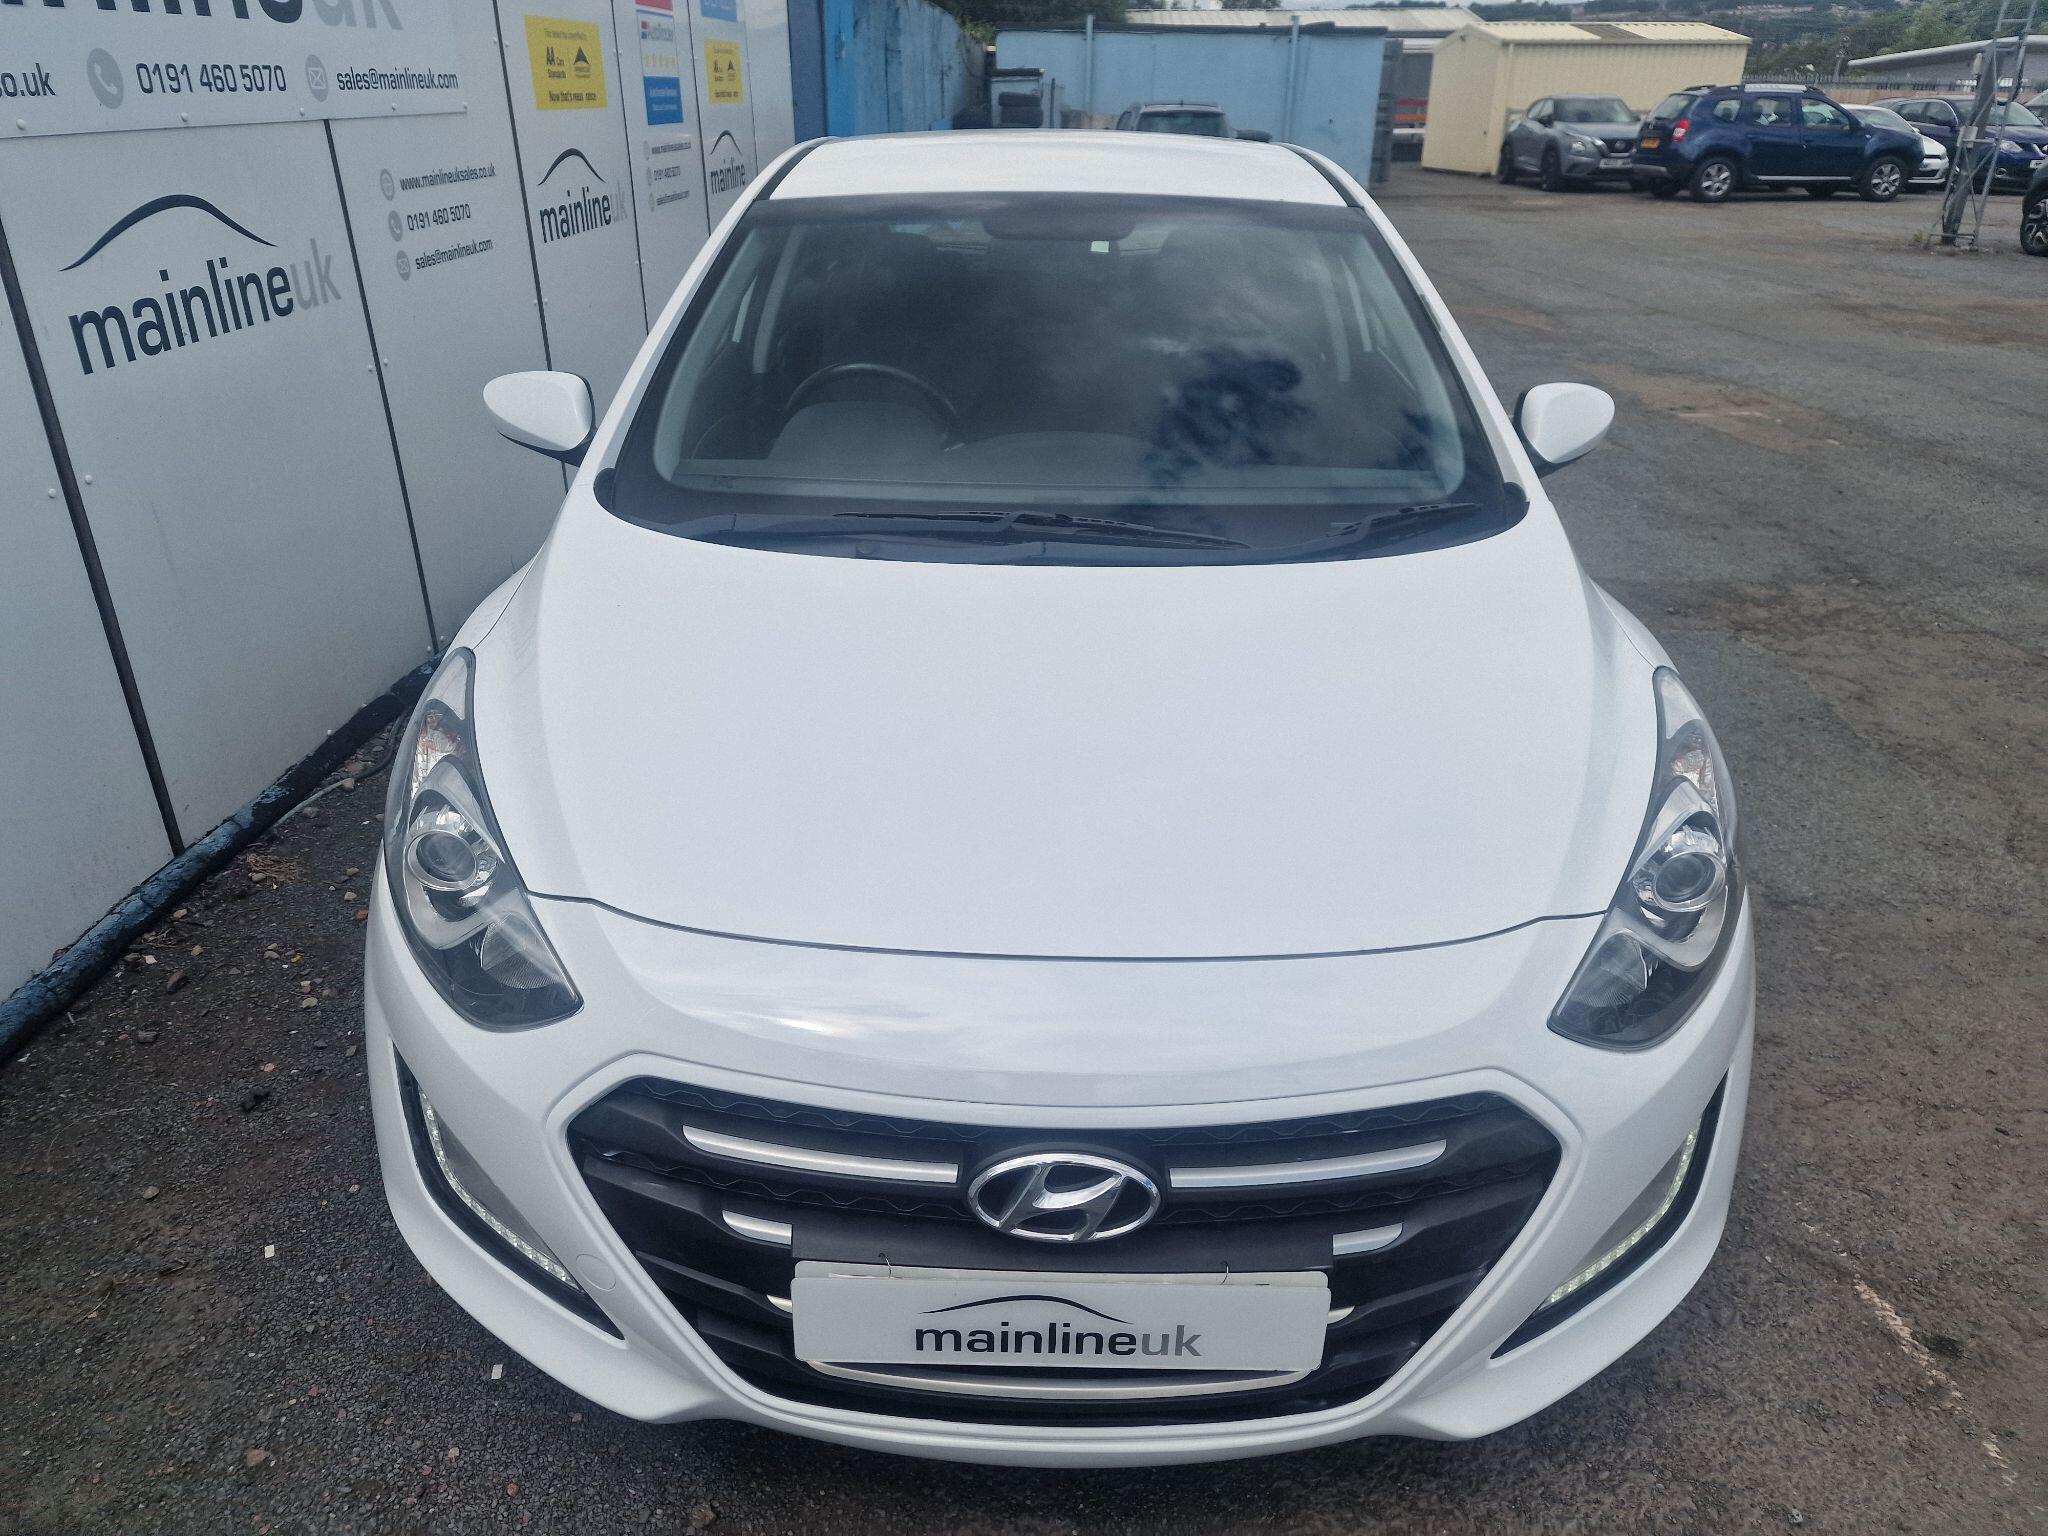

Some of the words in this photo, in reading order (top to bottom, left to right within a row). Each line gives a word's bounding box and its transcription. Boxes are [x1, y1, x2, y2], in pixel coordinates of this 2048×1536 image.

[135, 62, 194, 95] 0191
[199, 63, 238, 94] 460
[241, 64, 287, 93] 5070
[336, 64, 459, 91] sales@mainlineuk.com
[400, 163, 496, 191] www.mainlineuksales.co.uk
[406, 210, 431, 231] 0191
[432, 207, 450, 226] 460
[449, 203, 472, 222] 5070
[539, 179, 628, 244] mainlineuk
[415, 239, 494, 270] sales@mainlineuk.com
[68, 237, 342, 376] mainlineuk
[914, 1320, 1202, 1357] mainlineuk
